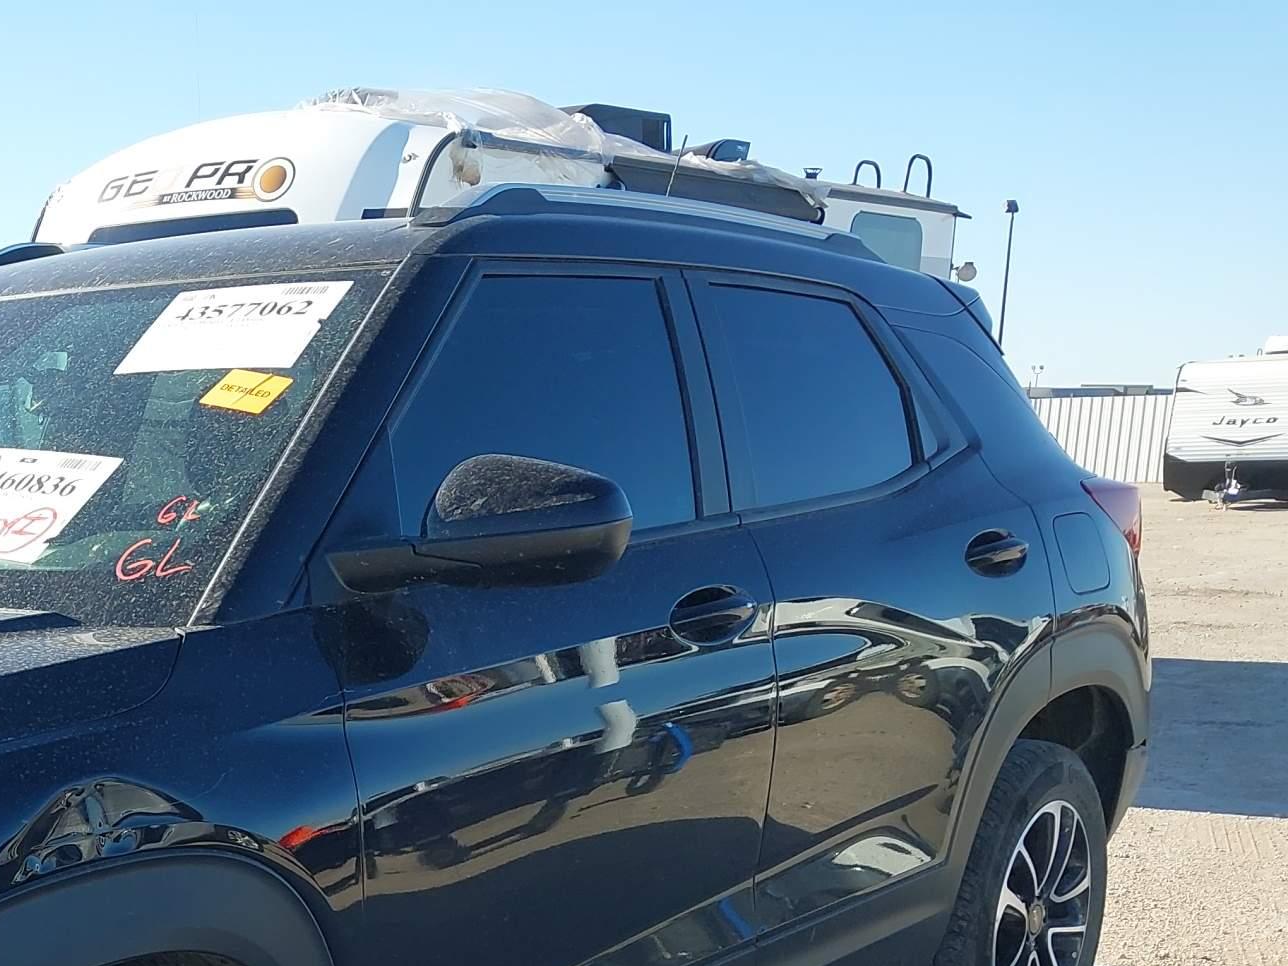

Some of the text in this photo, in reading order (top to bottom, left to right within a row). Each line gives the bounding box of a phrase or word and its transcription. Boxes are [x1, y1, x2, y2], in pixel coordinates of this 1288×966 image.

[171, 188, 231, 203] ROCKWOOD
[175, 300, 313, 321] 43577062
[219, 383, 272, 399] DETAILED
[1212, 415, 1280, 428] Jayco
[115, 537, 192, 580] GL
